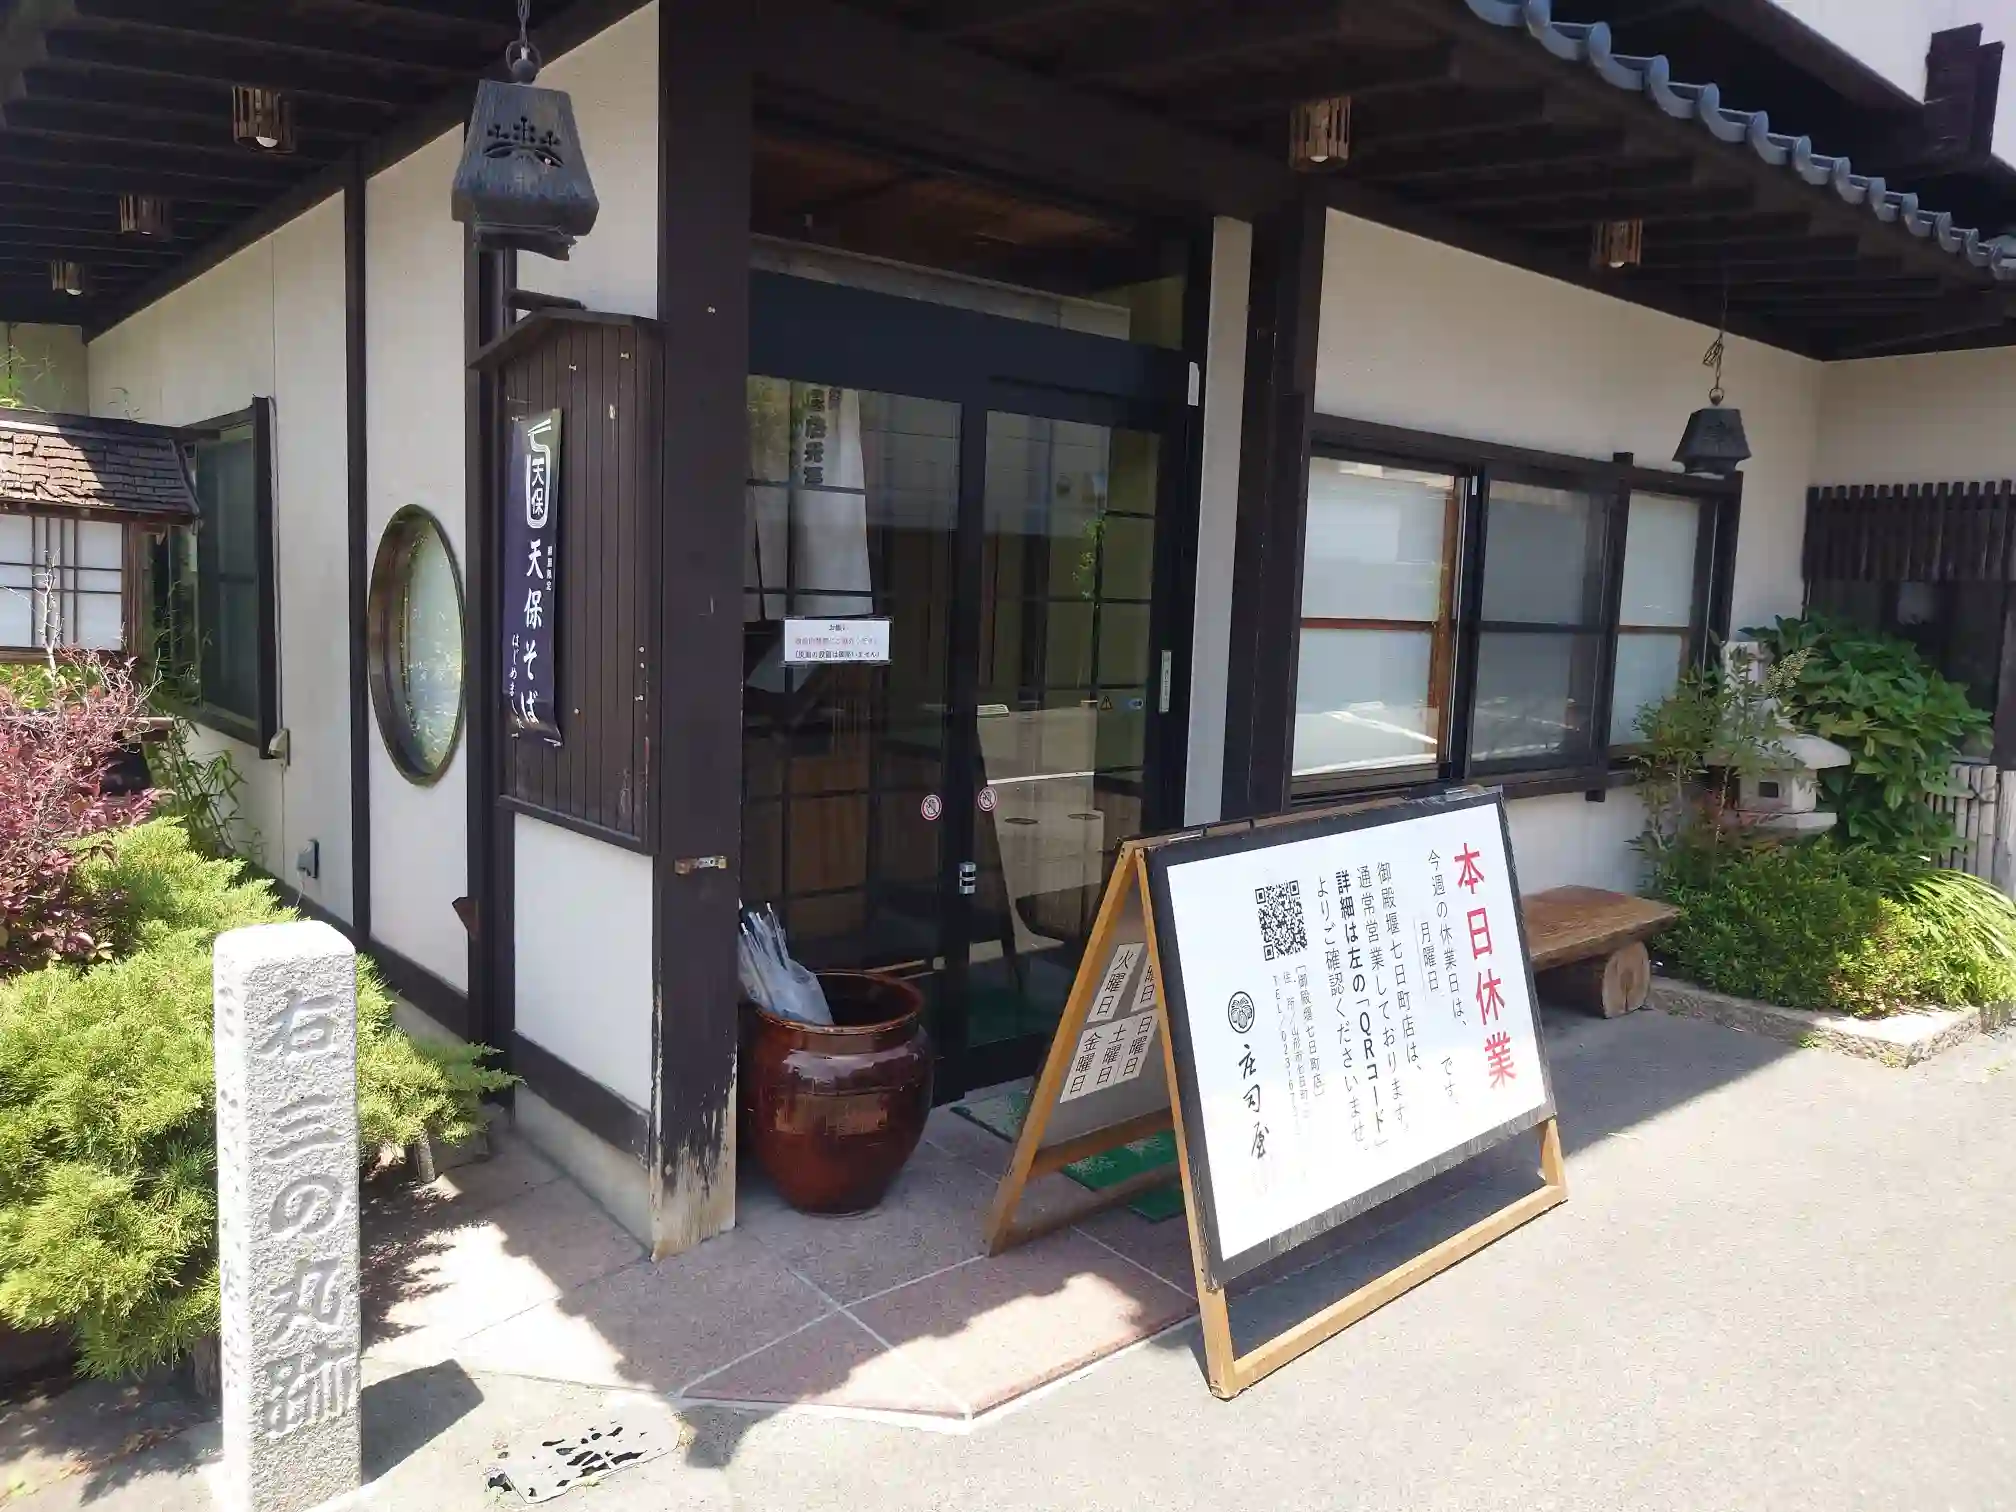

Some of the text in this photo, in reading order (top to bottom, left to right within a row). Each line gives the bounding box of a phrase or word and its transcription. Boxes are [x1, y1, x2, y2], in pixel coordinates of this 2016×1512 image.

[531, 457, 545, 515] 天保
[519, 538, 544, 725] 天保そば
[508, 633, 525, 730] はじめました
[1097, 949, 1134, 1015] 火曜日
[1377, 861, 1422, 1071] 御殿堰七日町店は、
[1420, 921, 1440, 994] 月曜日
[1428, 849, 1468, 1027] 今週の休業日は、
[1454, 842, 1516, 1091] 本日休業
[1123, 1015, 1153, 1077] 日曜日
[1317, 876, 1369, 1151] よりご確認くださいませ。
[1356, 865, 1410, 1133] 通常営業しております。
[1070, 1031, 1102, 1094] 金曜日
[1097, 1024, 1128, 1086] 土曜日
